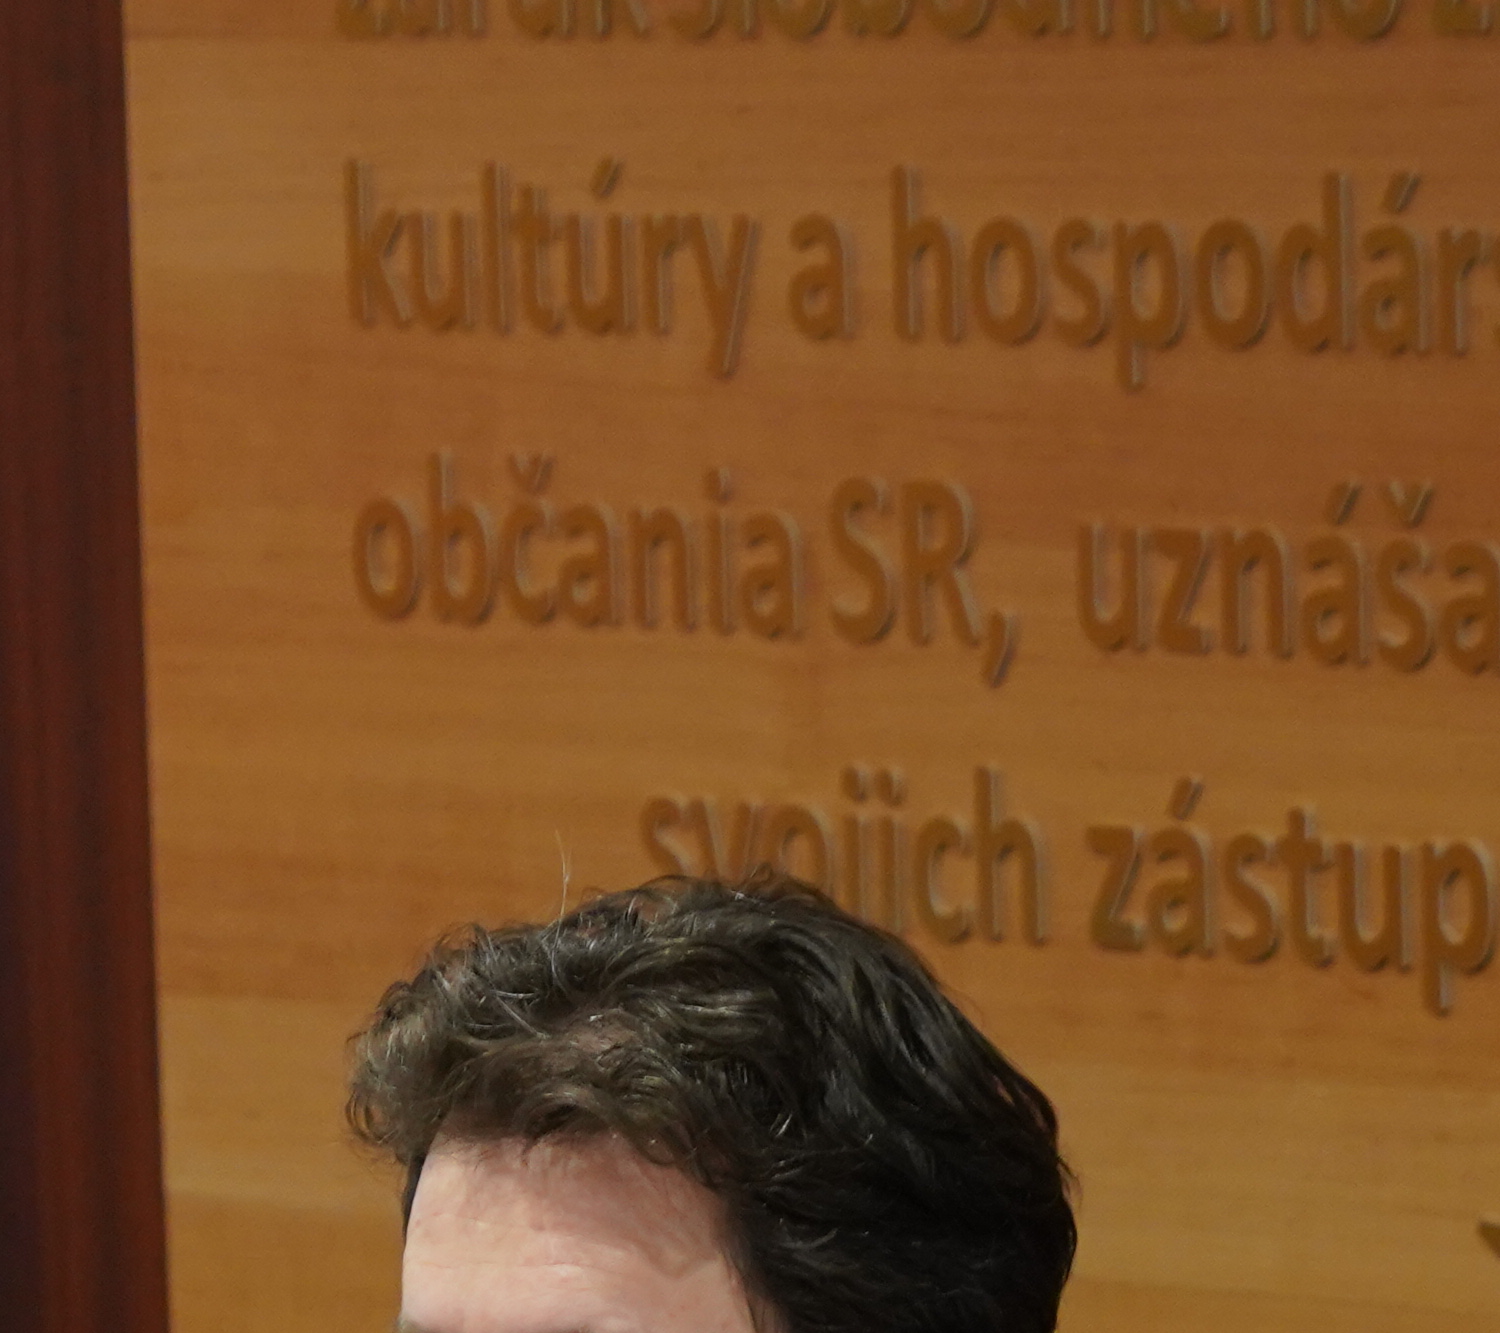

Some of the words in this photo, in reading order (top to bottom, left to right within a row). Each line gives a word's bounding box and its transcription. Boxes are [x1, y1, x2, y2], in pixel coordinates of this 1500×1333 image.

[343, 156, 760, 377] kultúry
[788, 211, 853, 342] a
[350, 449, 803, 639] občania
[827, 475, 1020, 683] SR,
